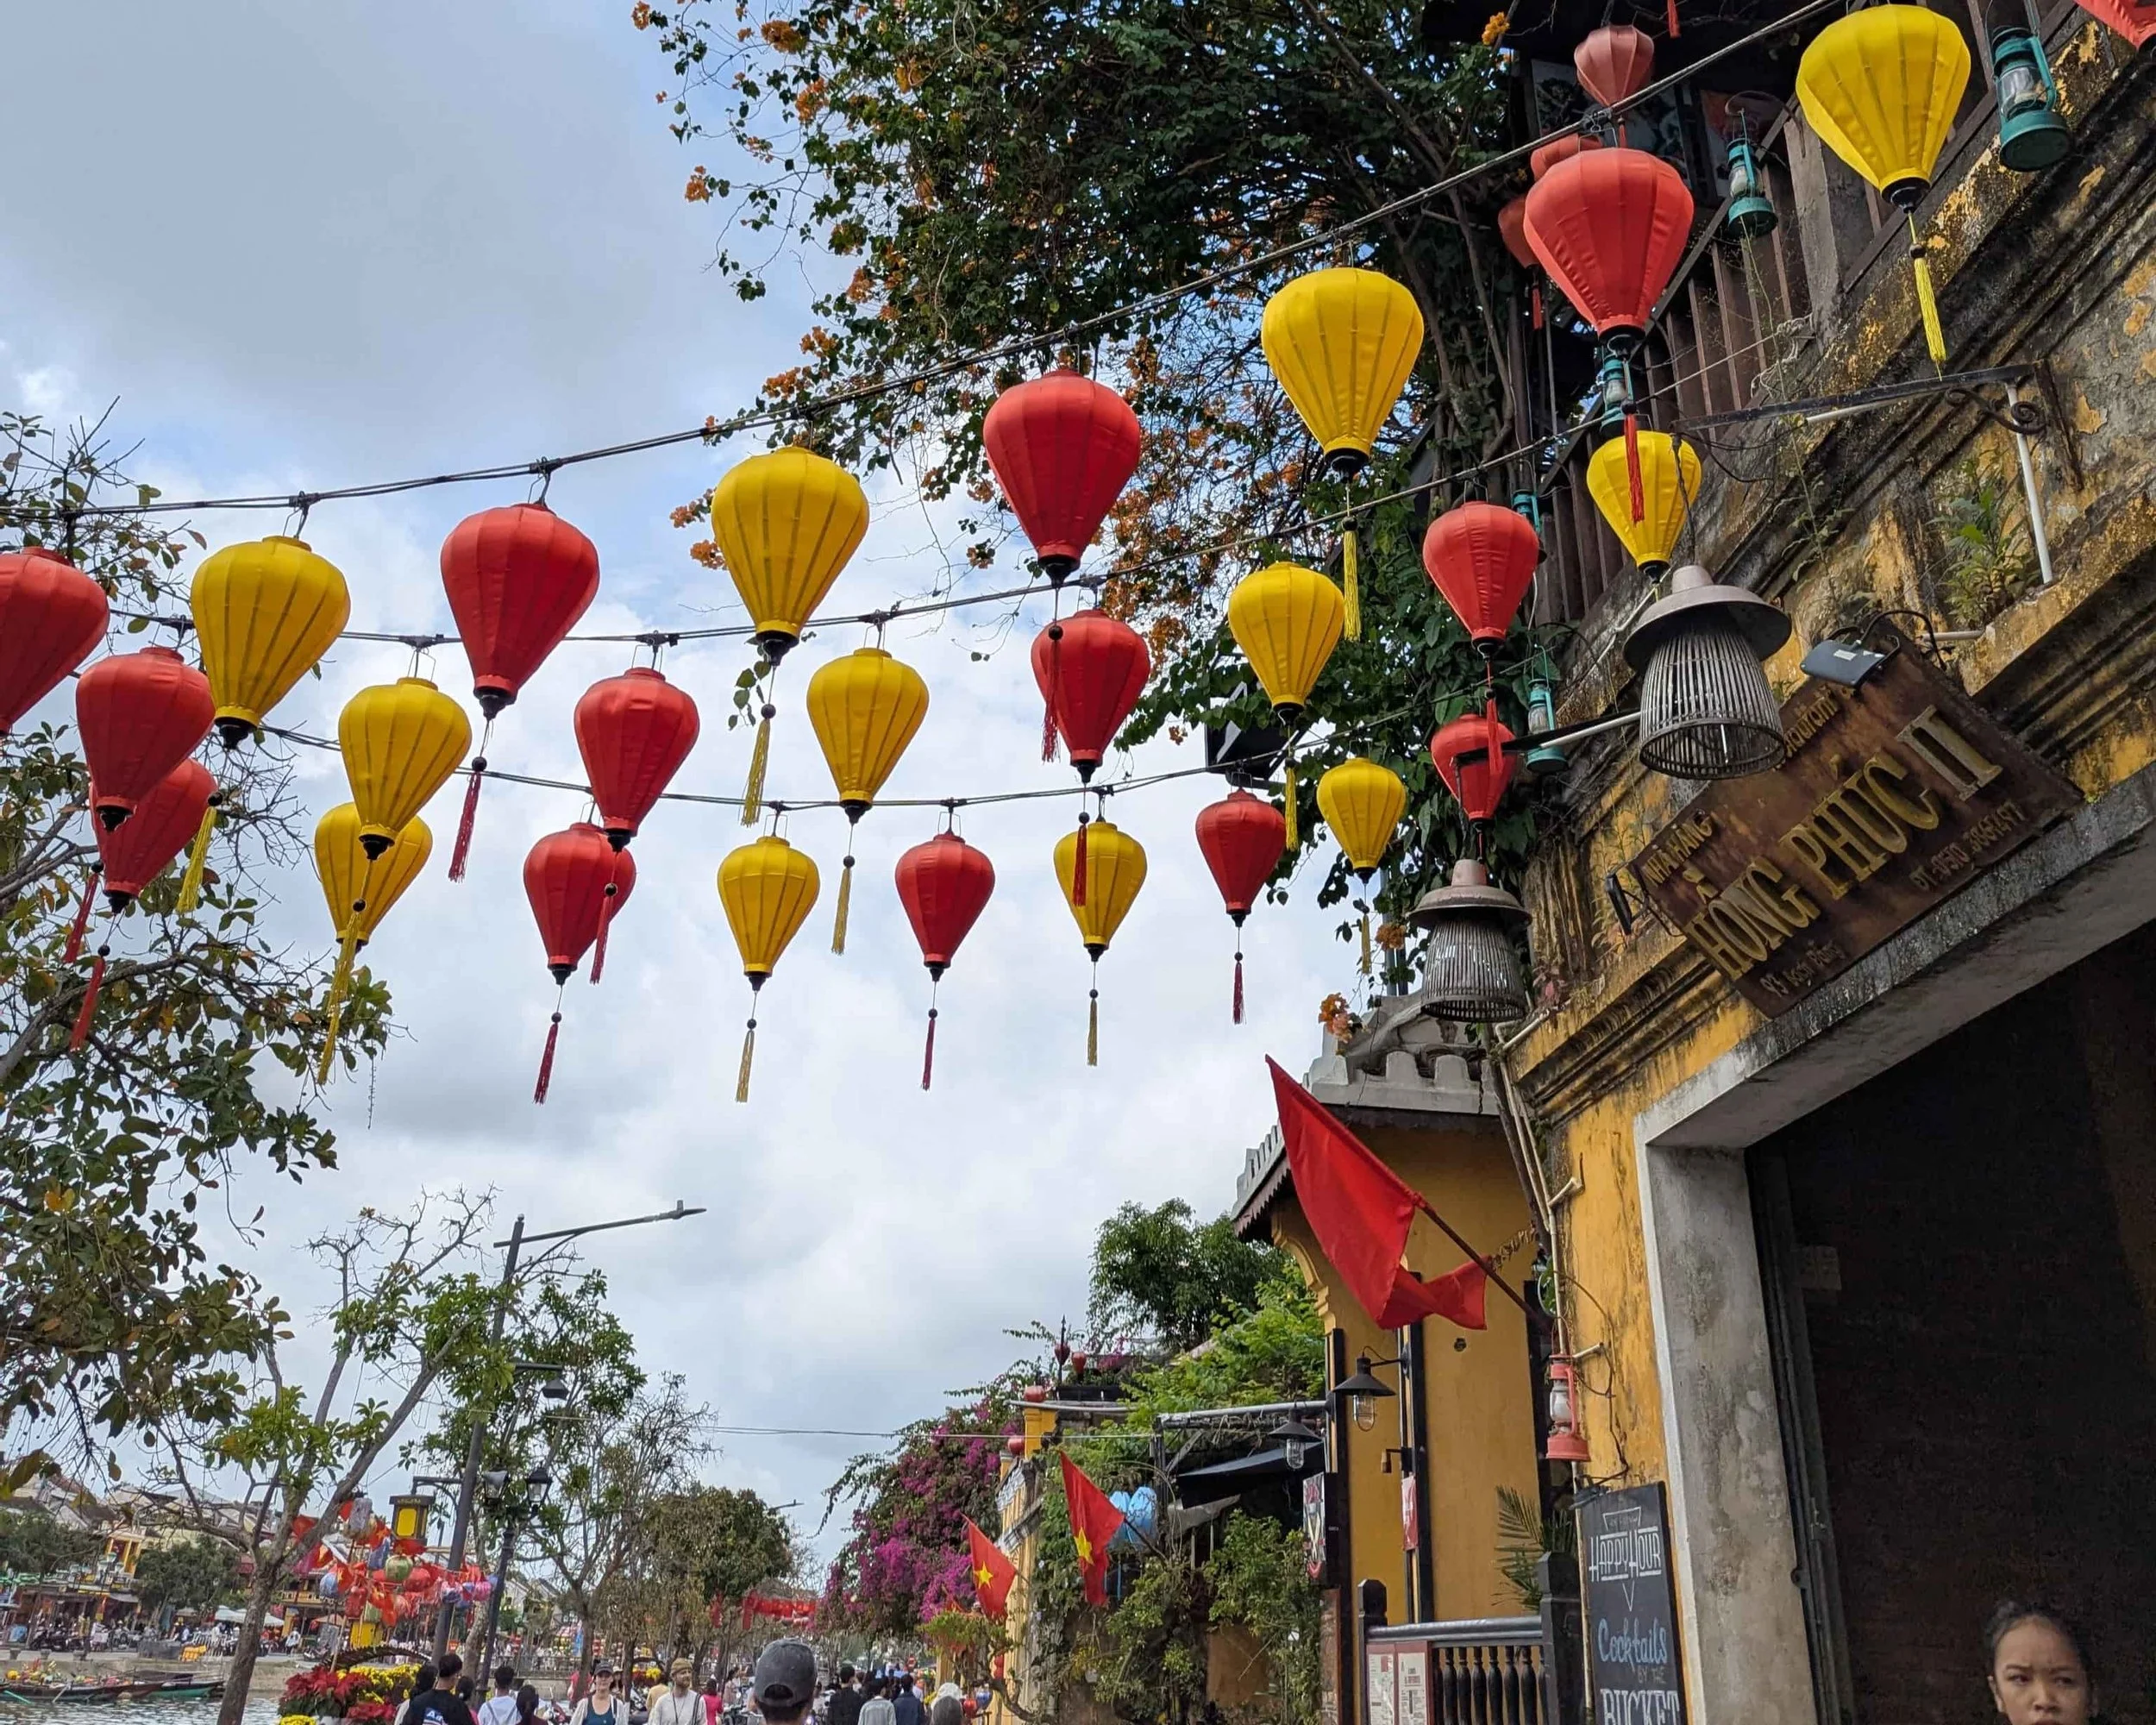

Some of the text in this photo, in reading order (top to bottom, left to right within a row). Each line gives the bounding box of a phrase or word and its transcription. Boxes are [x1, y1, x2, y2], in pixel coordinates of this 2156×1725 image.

[1683, 856, 1821, 980] HỒNG
[1779, 752, 1940, 900] PHÚC
[1589, 1528, 1662, 1583] HAPPY HOUR
[1597, 1616, 1668, 1673] Cocktails
[1600, 1688, 1680, 1725] BUCKET
